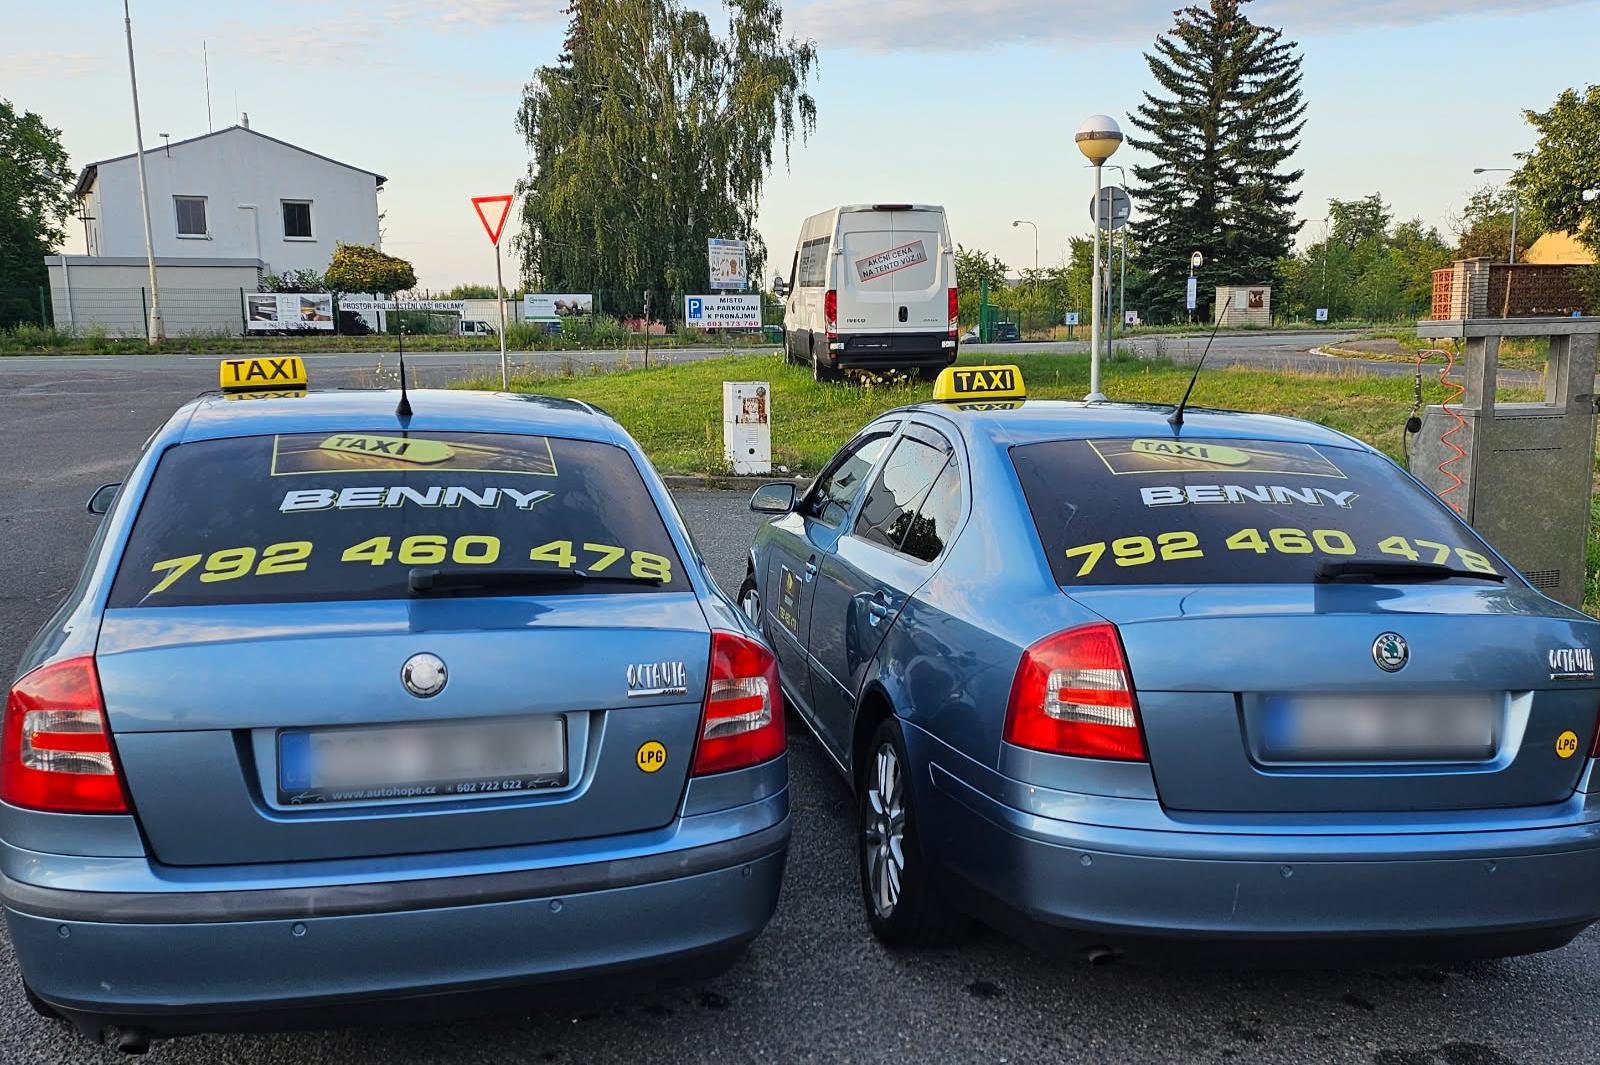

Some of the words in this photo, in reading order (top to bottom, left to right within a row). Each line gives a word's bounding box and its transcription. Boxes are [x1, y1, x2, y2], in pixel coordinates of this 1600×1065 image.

[892, 247, 913, 259] CENA
[862, 269, 875, 278] NA
[875, 260, 900, 273] TENTO
[342, 302, 372, 310] PROSTOR
[434, 302, 464, 310] REKLAMY
[226, 359, 298, 381] TAXI
[957, 371, 1012, 390] TAXI
[336, 437, 411, 455] TAXI
[1140, 441, 1210, 459] TAXI
[279, 486, 555, 513] BENNY
[1140, 485, 1361, 509] BENNY
[1065, 531, 1205, 577] 792
[1225, 528, 1357, 555] 460
[1378, 535, 1498, 576] 478
[149, 541, 314, 594] 792
[341, 535, 501, 566] 460
[530, 540, 673, 584] 478
[1548, 648, 1594, 672] OCTAVIA
[627, 661, 687, 689] OCTAVIA
[1558, 738, 1576, 751] LPG
[640, 750, 663, 764] LPG
[332, 786, 437, 800] www.autohope.cz
[456, 783, 477, 793] 602
[479, 781, 499, 791] 722
[502, 780, 522, 790] 622
